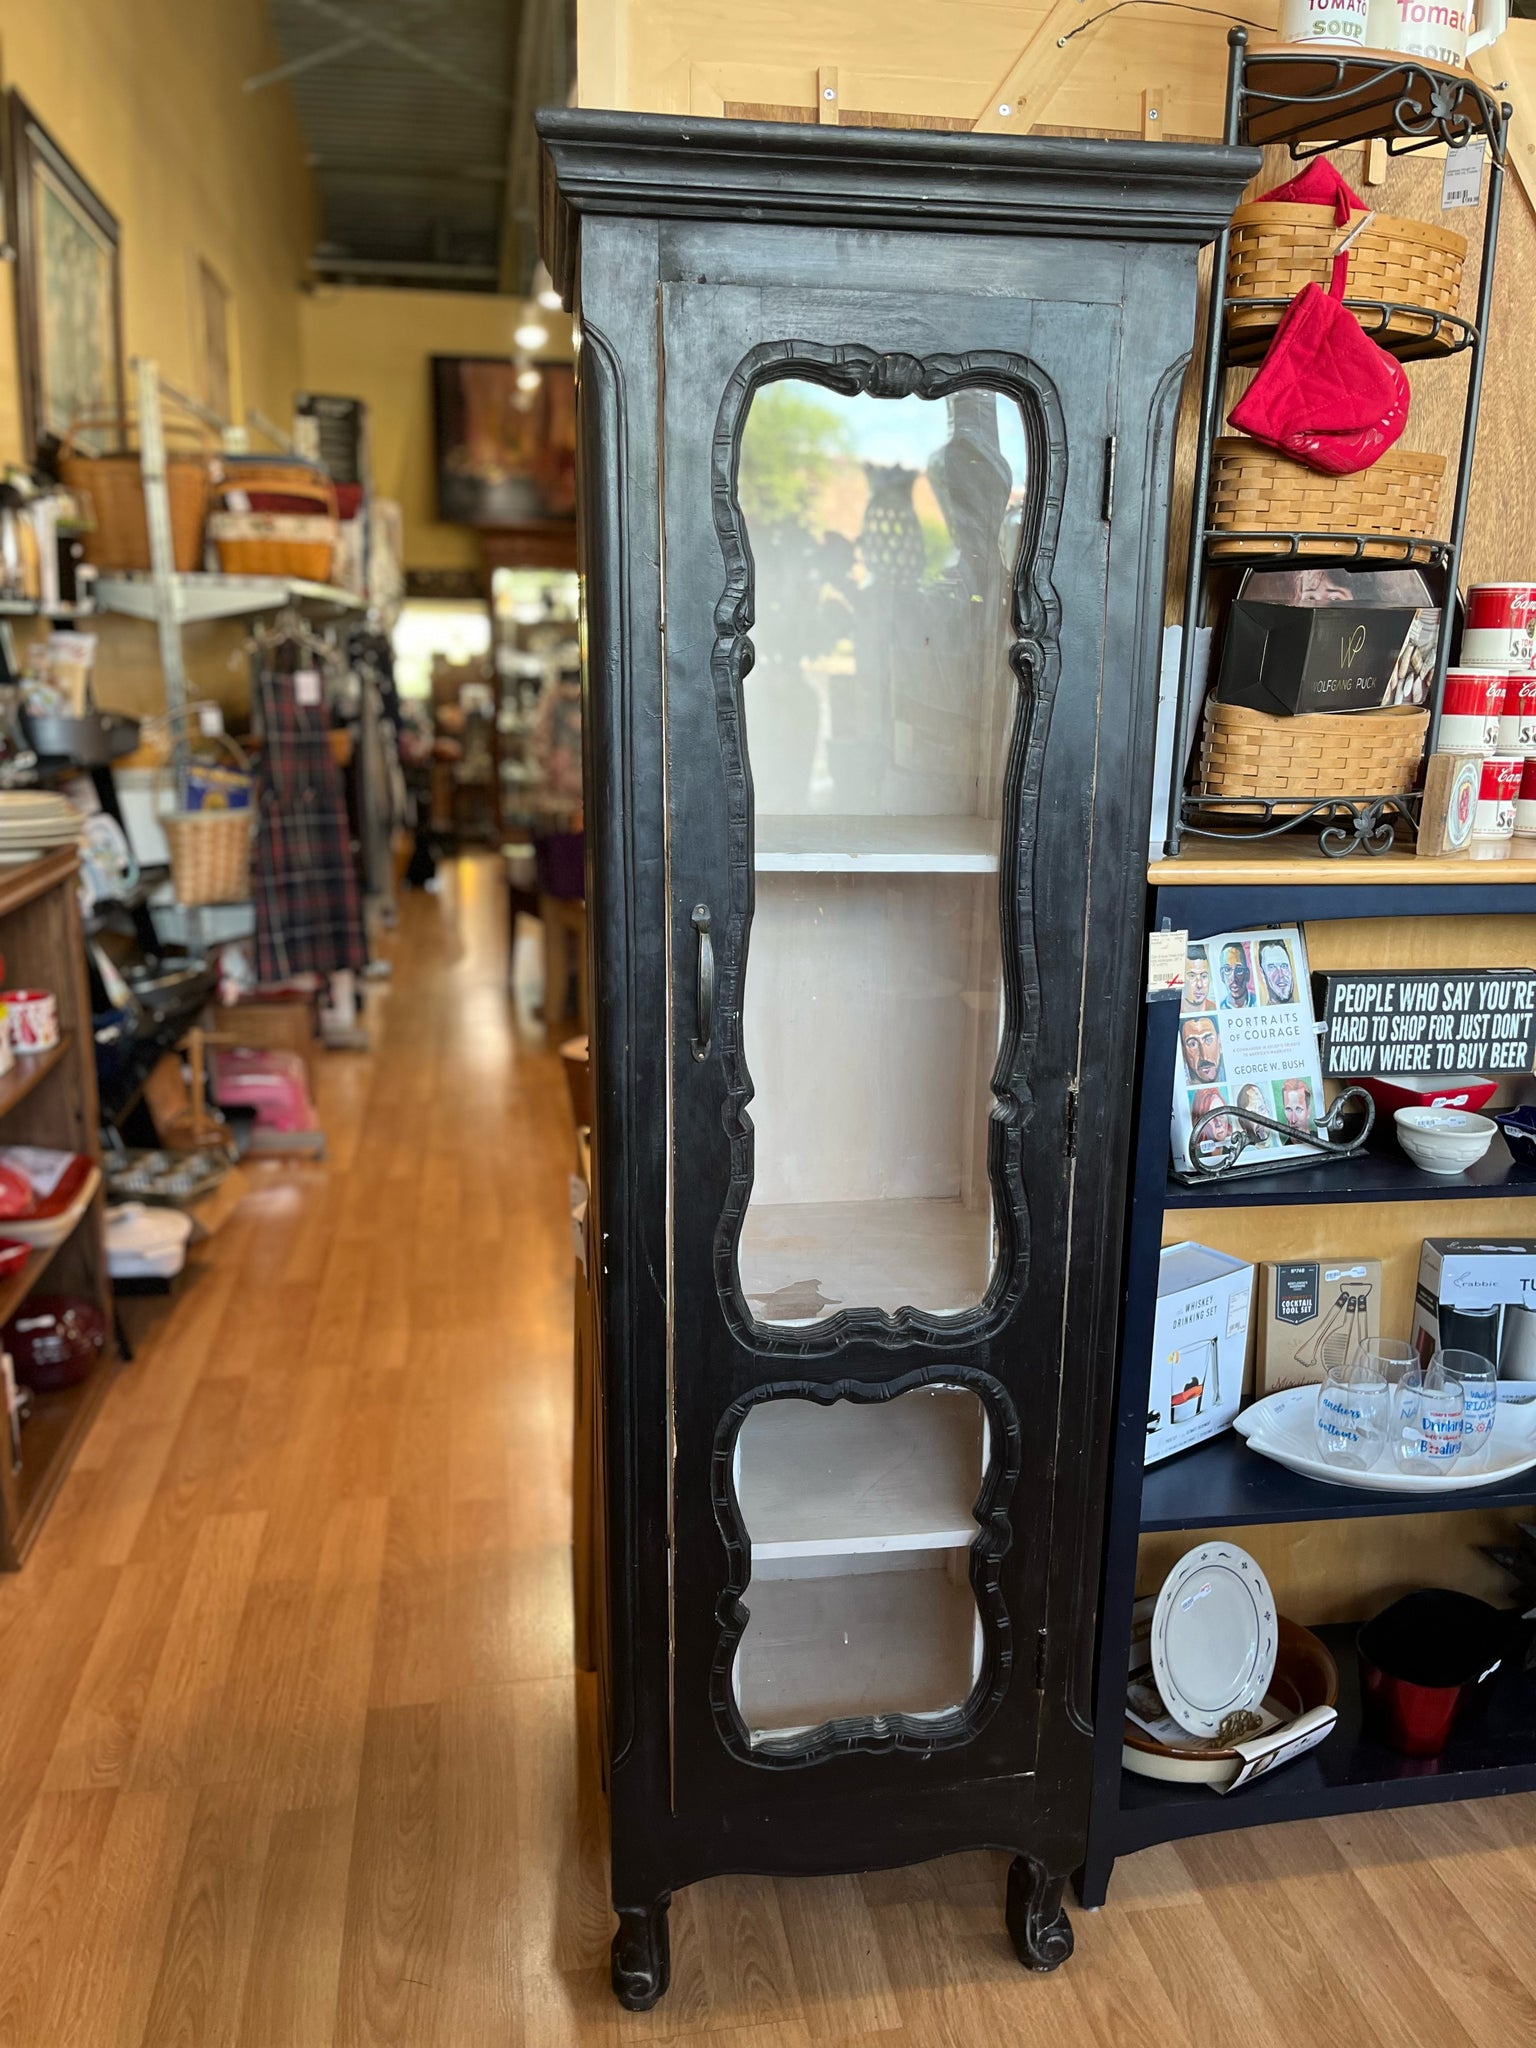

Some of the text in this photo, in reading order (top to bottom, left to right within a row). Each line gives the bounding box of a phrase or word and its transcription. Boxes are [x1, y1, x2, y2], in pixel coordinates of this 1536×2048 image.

[1312, 20, 1363, 39] SOUP
[1313, 677, 1377, 694] WOLFGANG PUCK
[1333, 980, 1536, 1013] PEOPLE WHO SAY YOU'RE
[1227, 1012, 1299, 1029] PORTRAITS
[1330, 1012, 1533, 1042] HARD TO SHOP FOR JUST DON'T
[1229, 1025, 1301, 1042] OF COURAGE
[1328, 1041, 1528, 1072] KNOW WHERE TO BUY BEER
[1234, 1059, 1305, 1075] GEORGE W. BUSH
[1185, 1295, 1214, 1313] WHISKEY
[1281, 1299, 1313, 1308] COCKTAIL
[1282, 1305, 1312, 1315] TOOL SET
[1172, 1305, 1218, 1330] DRINKING SET
